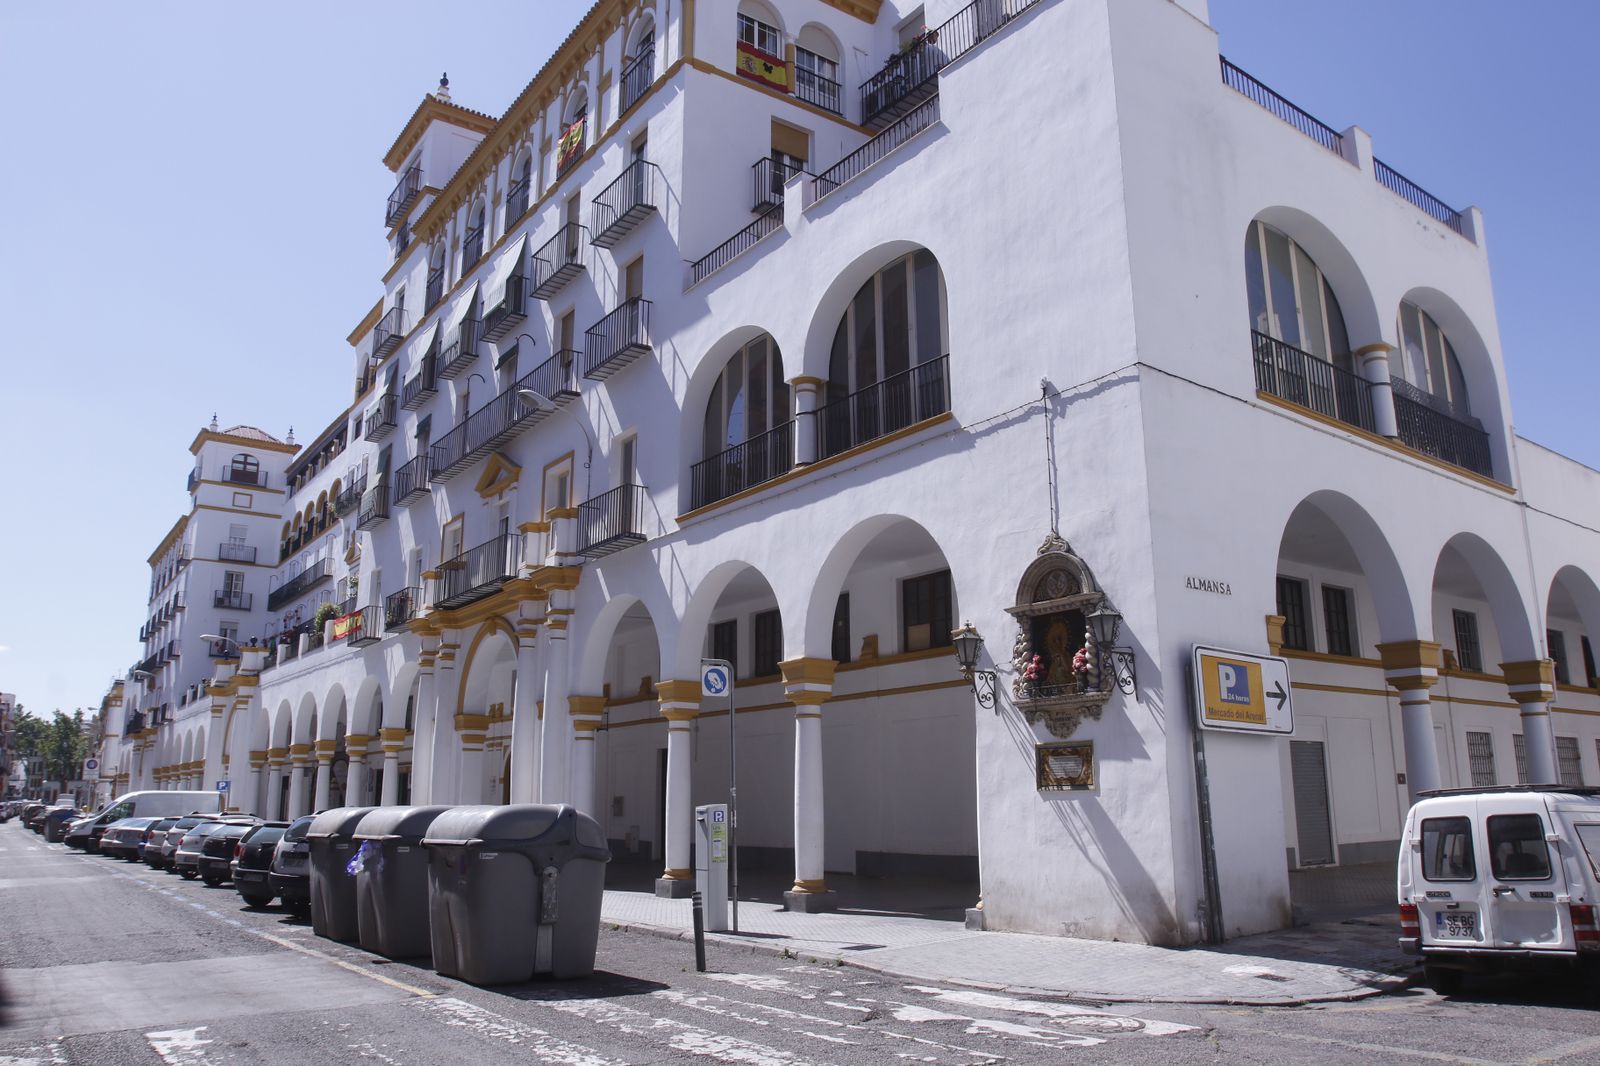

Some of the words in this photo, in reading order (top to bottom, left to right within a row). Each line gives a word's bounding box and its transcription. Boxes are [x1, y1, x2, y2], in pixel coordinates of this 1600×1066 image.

[1186, 576, 1232, 595] ALMANSA
[1218, 664, 1236, 700] P
[218, 781, 227, 790] P
[1446, 915, 1459, 926] SE
[1460, 914, 1474, 926] BG
[1449, 926, 1474, 937] 9737
